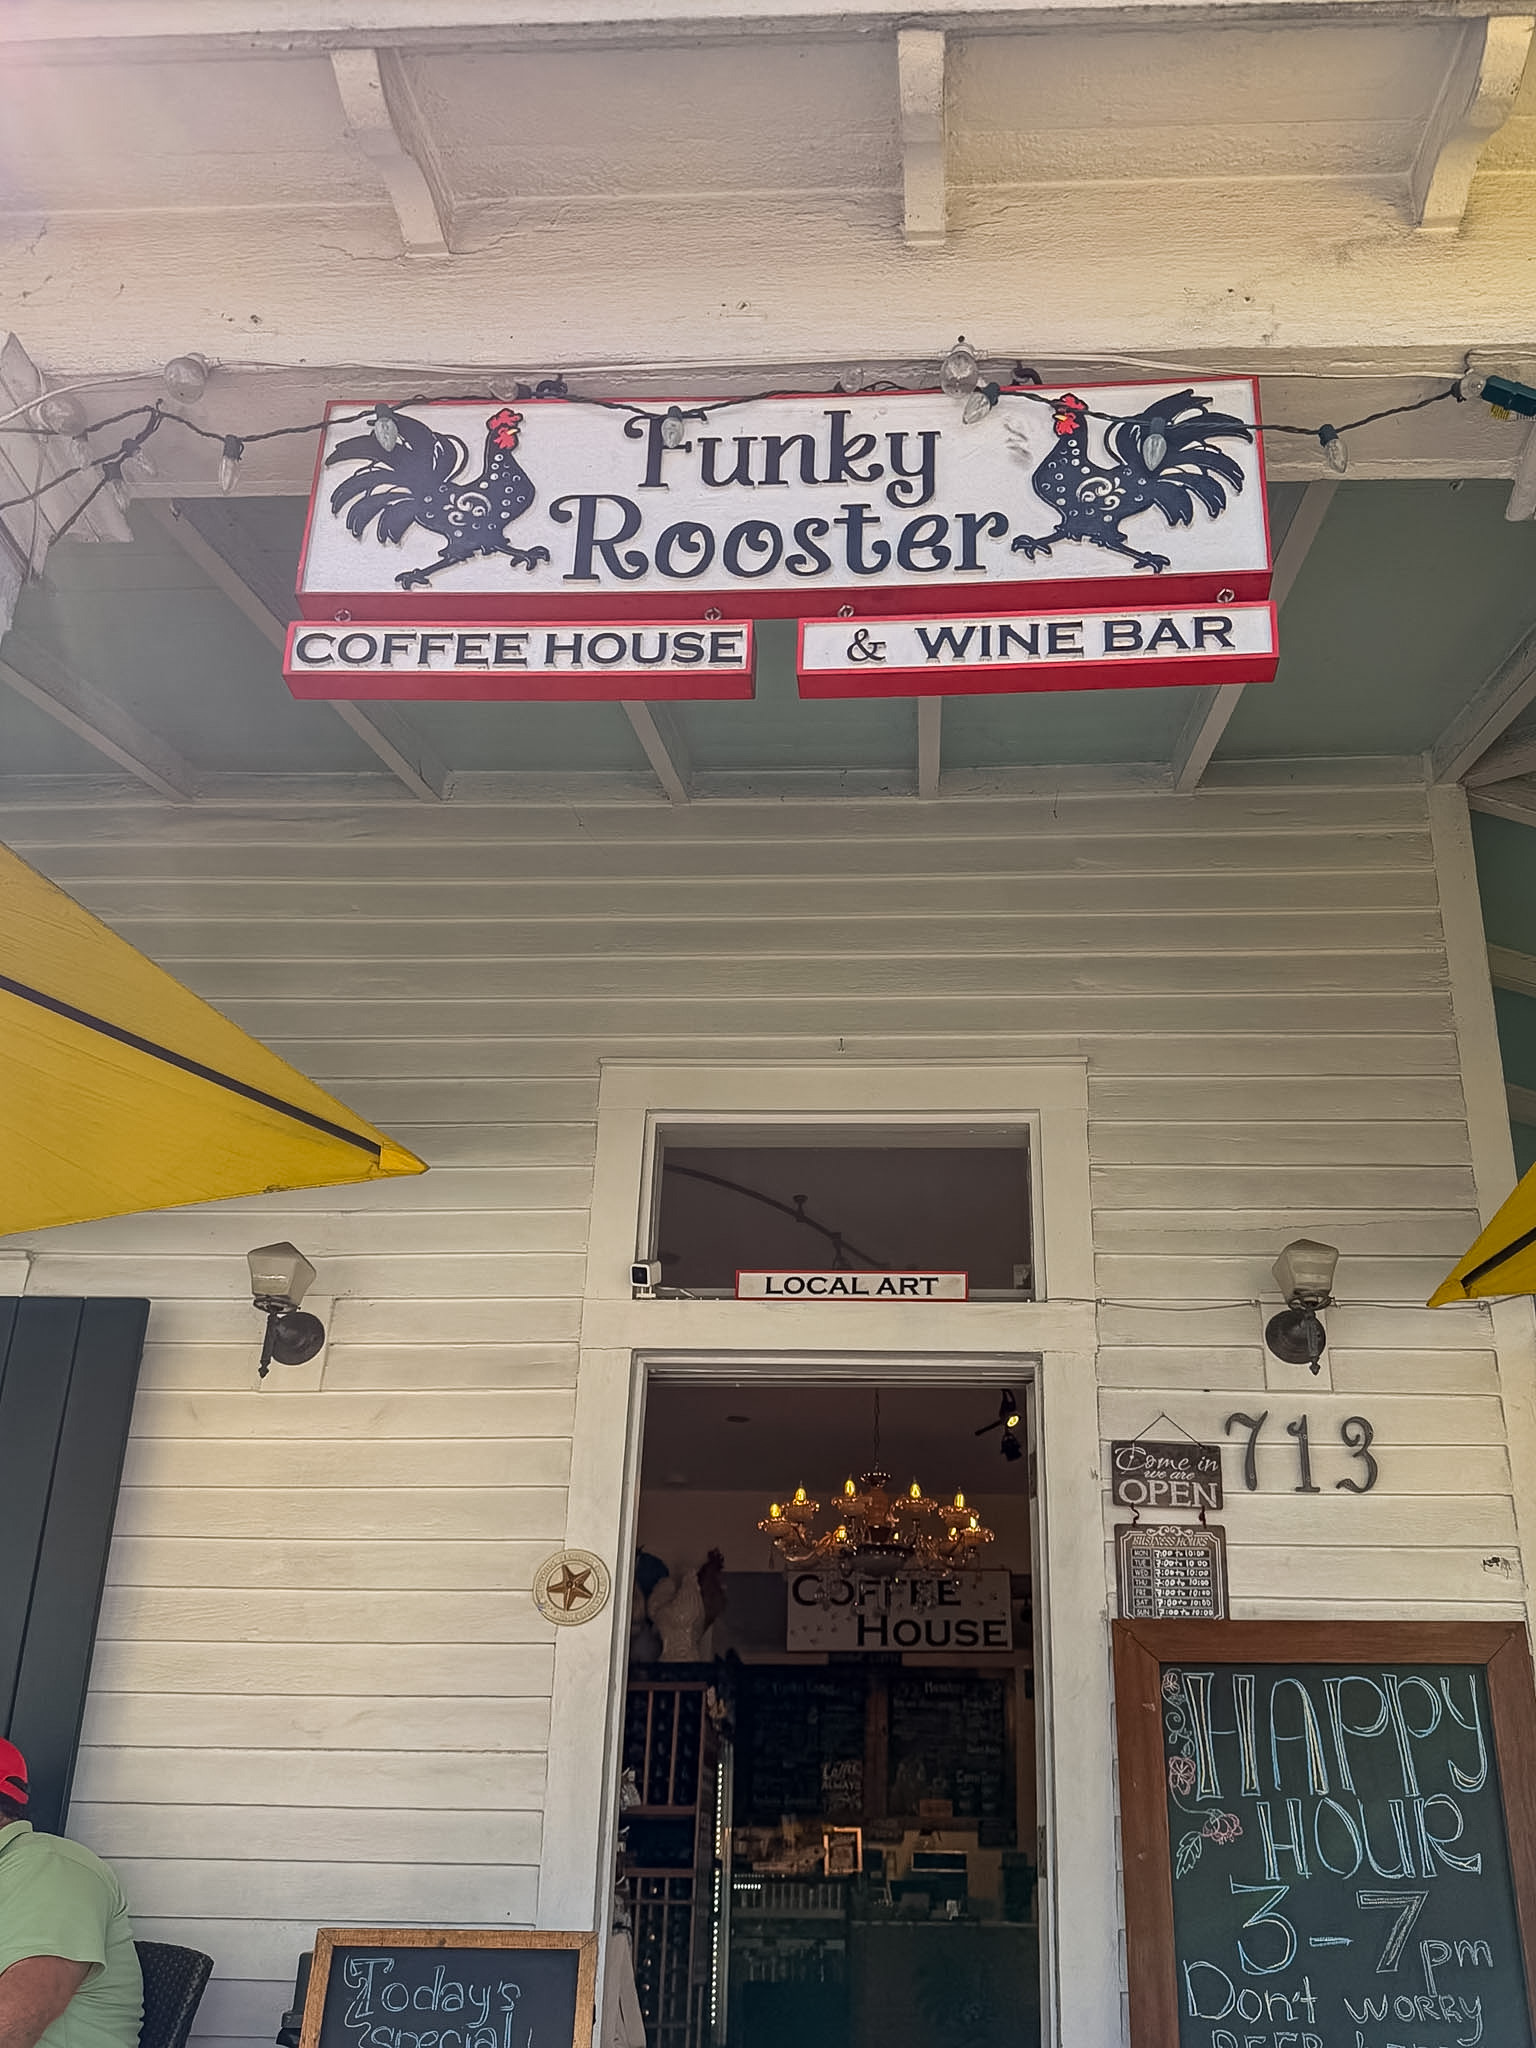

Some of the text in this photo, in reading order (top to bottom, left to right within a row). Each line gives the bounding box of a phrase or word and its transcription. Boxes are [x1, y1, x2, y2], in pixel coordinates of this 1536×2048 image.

[624, 409, 942, 509] Funky
[550, 494, 1009, 582] Rooster
[296, 631, 743, 666] COFFEE HOUSE
[847, 615, 1235, 662] & WINE BAR
[765, 1276, 939, 1296] LOCAL ART
[1115, 1444, 1218, 1474] Come in
[1144, 1470, 1195, 1480] we are
[1225, 1410, 1378, 1493] 713
[1119, 1479, 1218, 1508] OPEN
[857, 1615, 1008, 1647] HOUSE
[1182, 1672, 1488, 1801] HAPPY
[1256, 1793, 1482, 1880] HOUR
[350, 1957, 521, 2028] Today's
[1183, 1959, 1318, 2024] Don't
[1420, 1939, 1494, 1997] pm
